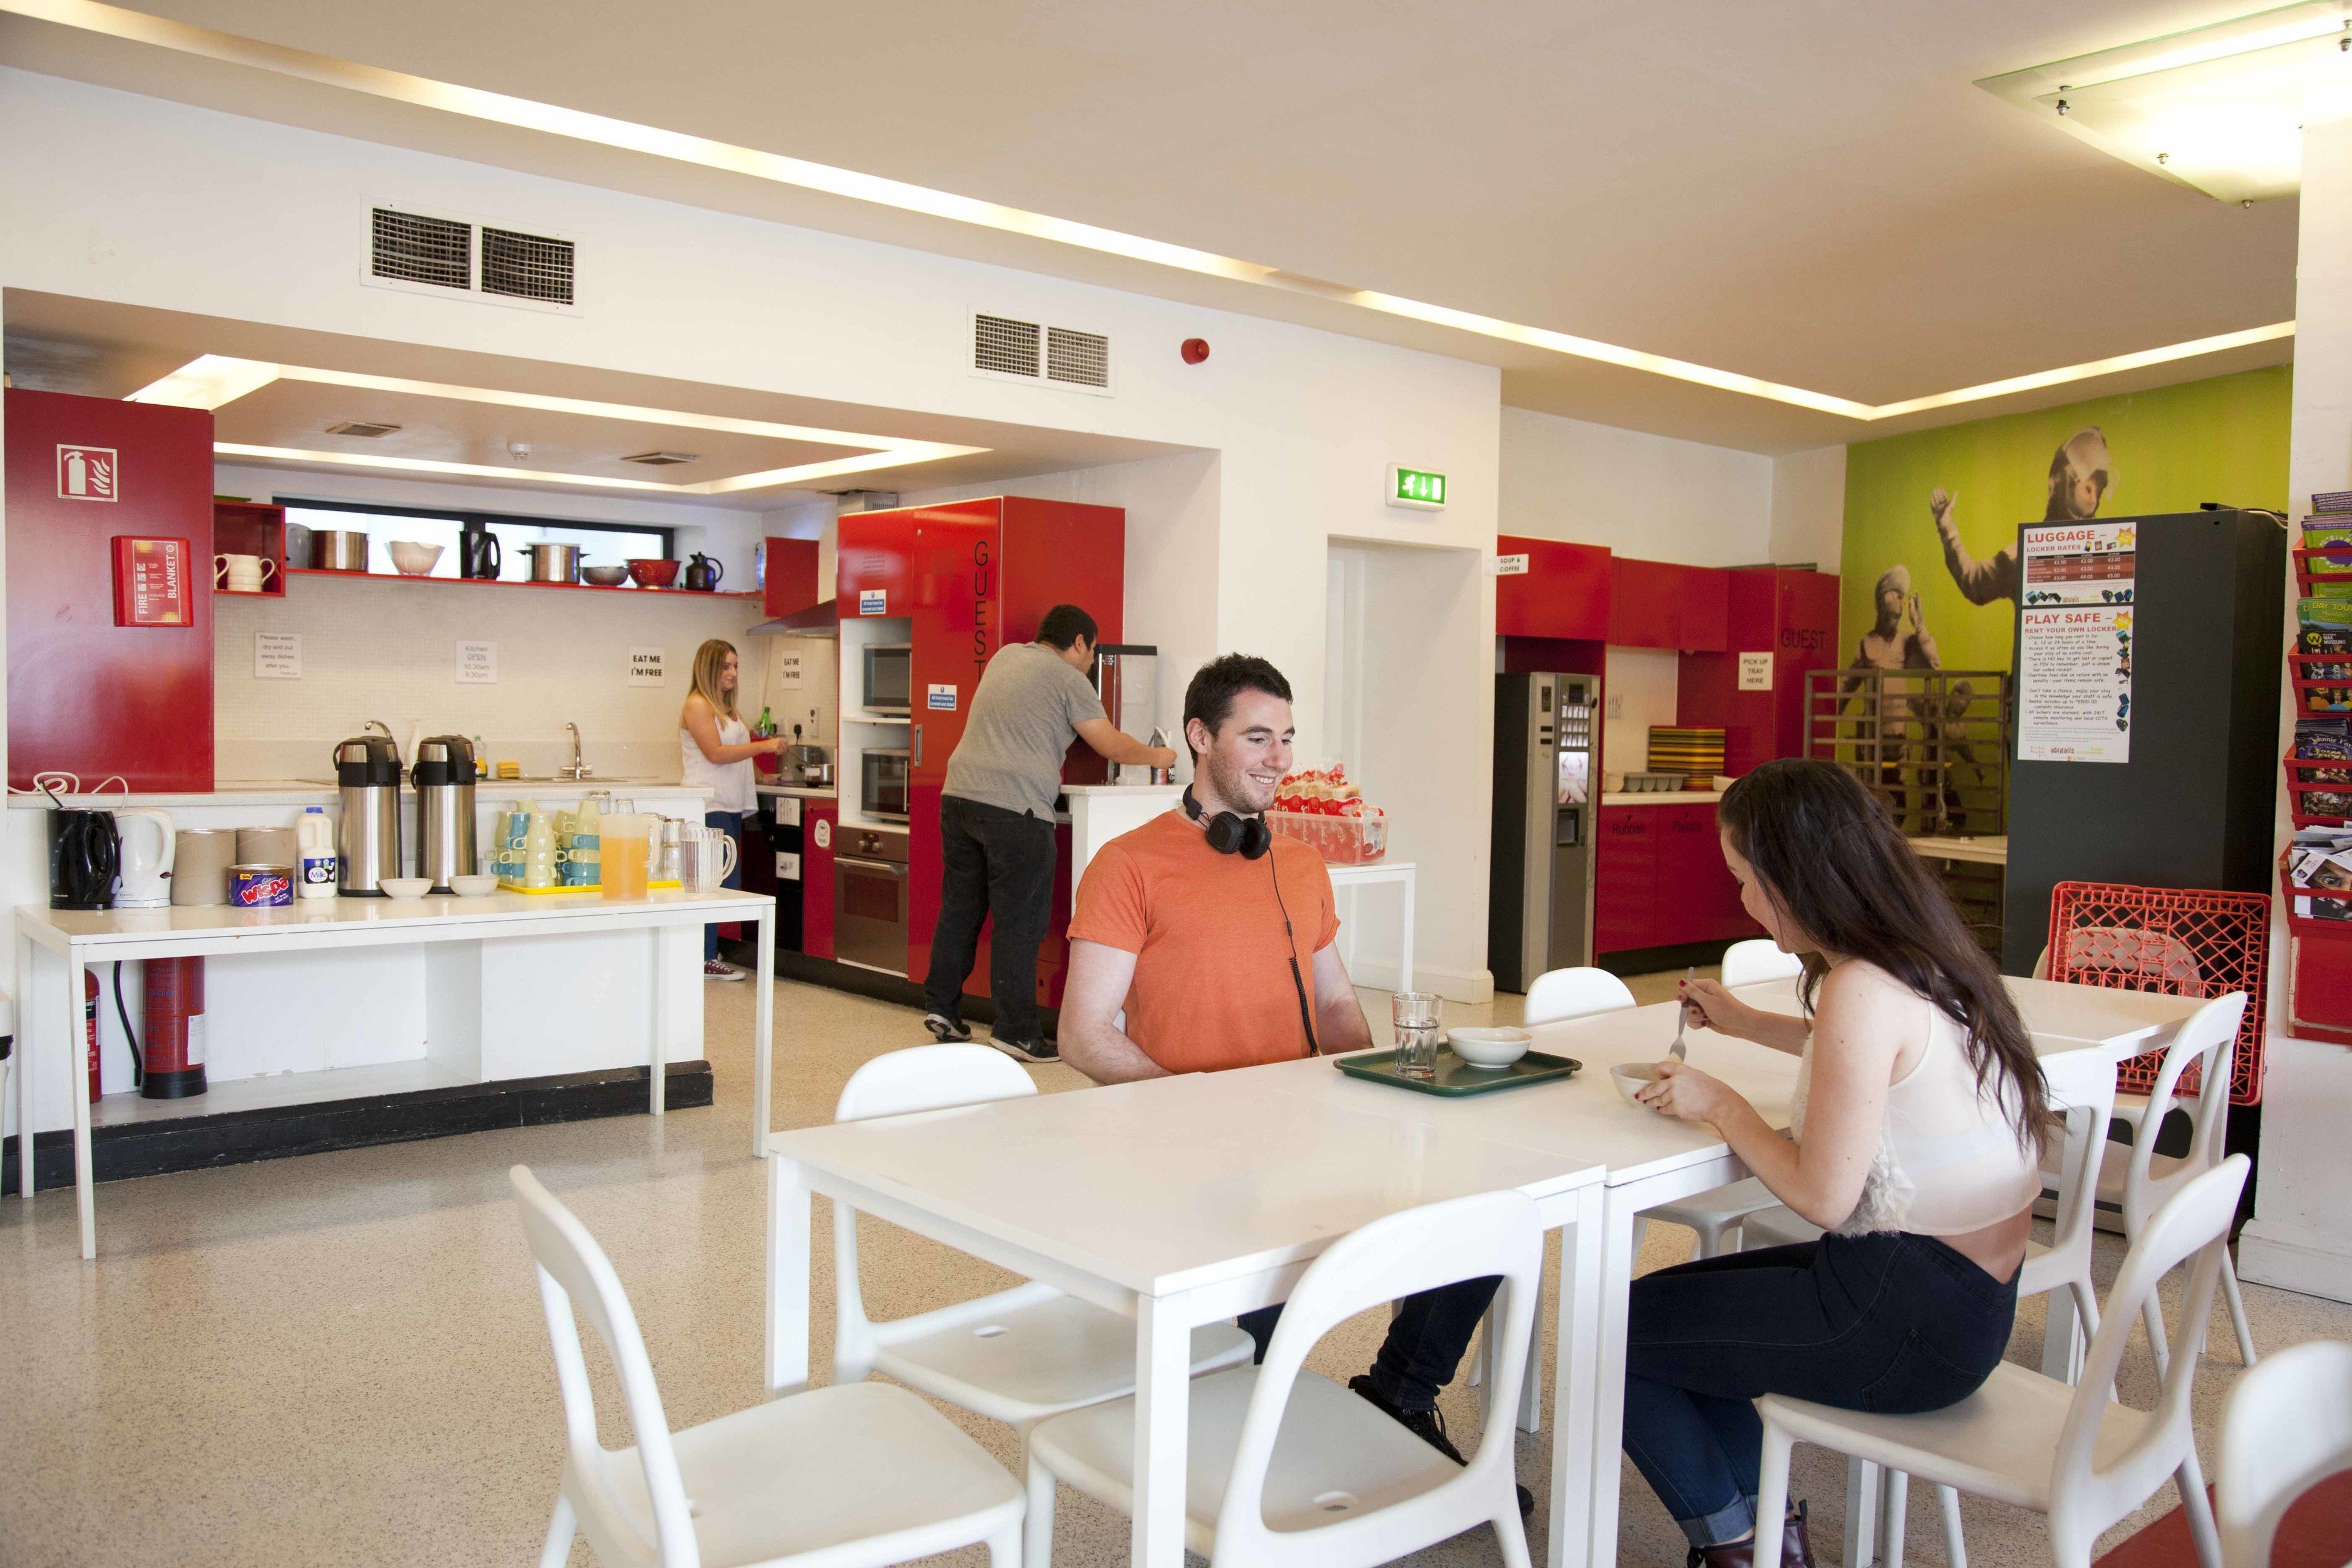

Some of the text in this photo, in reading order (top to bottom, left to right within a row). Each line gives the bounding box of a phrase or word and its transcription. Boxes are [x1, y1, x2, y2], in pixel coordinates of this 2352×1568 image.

[2027, 530, 2095, 543] LUGGAGE
[166, 554, 177, 598] BLANKET
[138, 594, 148, 614] FIRE
[974, 541, 988, 685] GUEST
[2026, 613, 2100, 624] PLAY SAFE
[1781, 628, 1826, 649] GUEST
[631, 667, 643, 676] I'M
[1612, 823, 1645, 834] Rubbish
